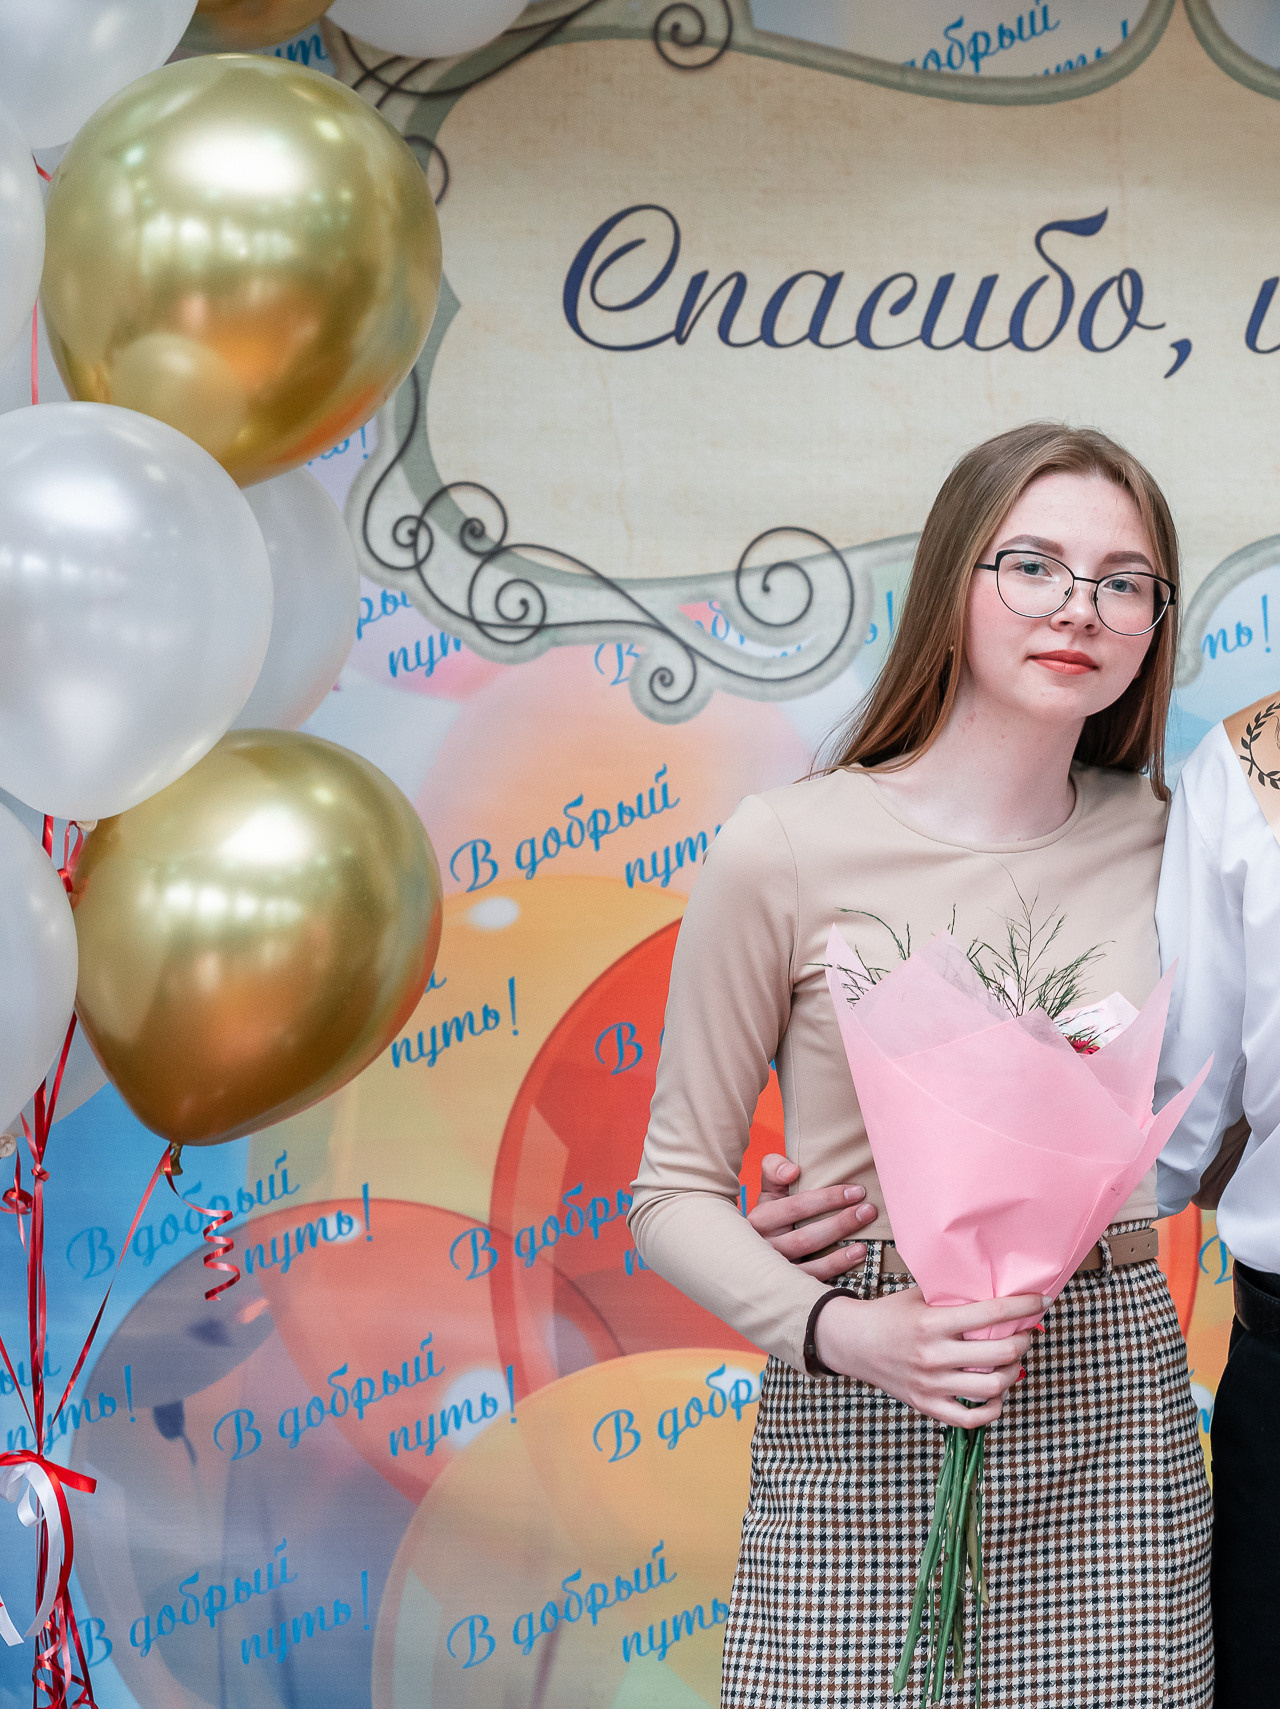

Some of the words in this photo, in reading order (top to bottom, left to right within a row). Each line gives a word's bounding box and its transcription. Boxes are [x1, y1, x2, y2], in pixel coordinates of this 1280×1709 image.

[900, 0, 1061, 75] обрый
[563, 204, 1192, 379] Спасибо,
[450, 838, 499, 893] В
[514, 764, 680, 880] добрый
[625, 824, 722, 889] пут
[391, 976, 519, 1068] путь!
[594, 1022, 643, 1076] В
[66, 1227, 115, 1280] В
[132, 1150, 299, 1267] добрый
[245, 1182, 373, 1274] путь!
[450, 1227, 499, 1281] В
[515, 1182, 635, 1268] добр
[213, 1409, 262, 1461] В
[278, 1332, 445, 1449] добрый
[389, 1365, 518, 1457] путь!
[593, 1409, 641, 1463] В
[657, 1364, 764, 1450] добр
[130, 1538, 298, 1657] добрый
[241, 1570, 370, 1664] путь!
[446, 1614, 496, 1669] В
[512, 1539, 678, 1655] добрый
[621, 1597, 730, 1662] путь
